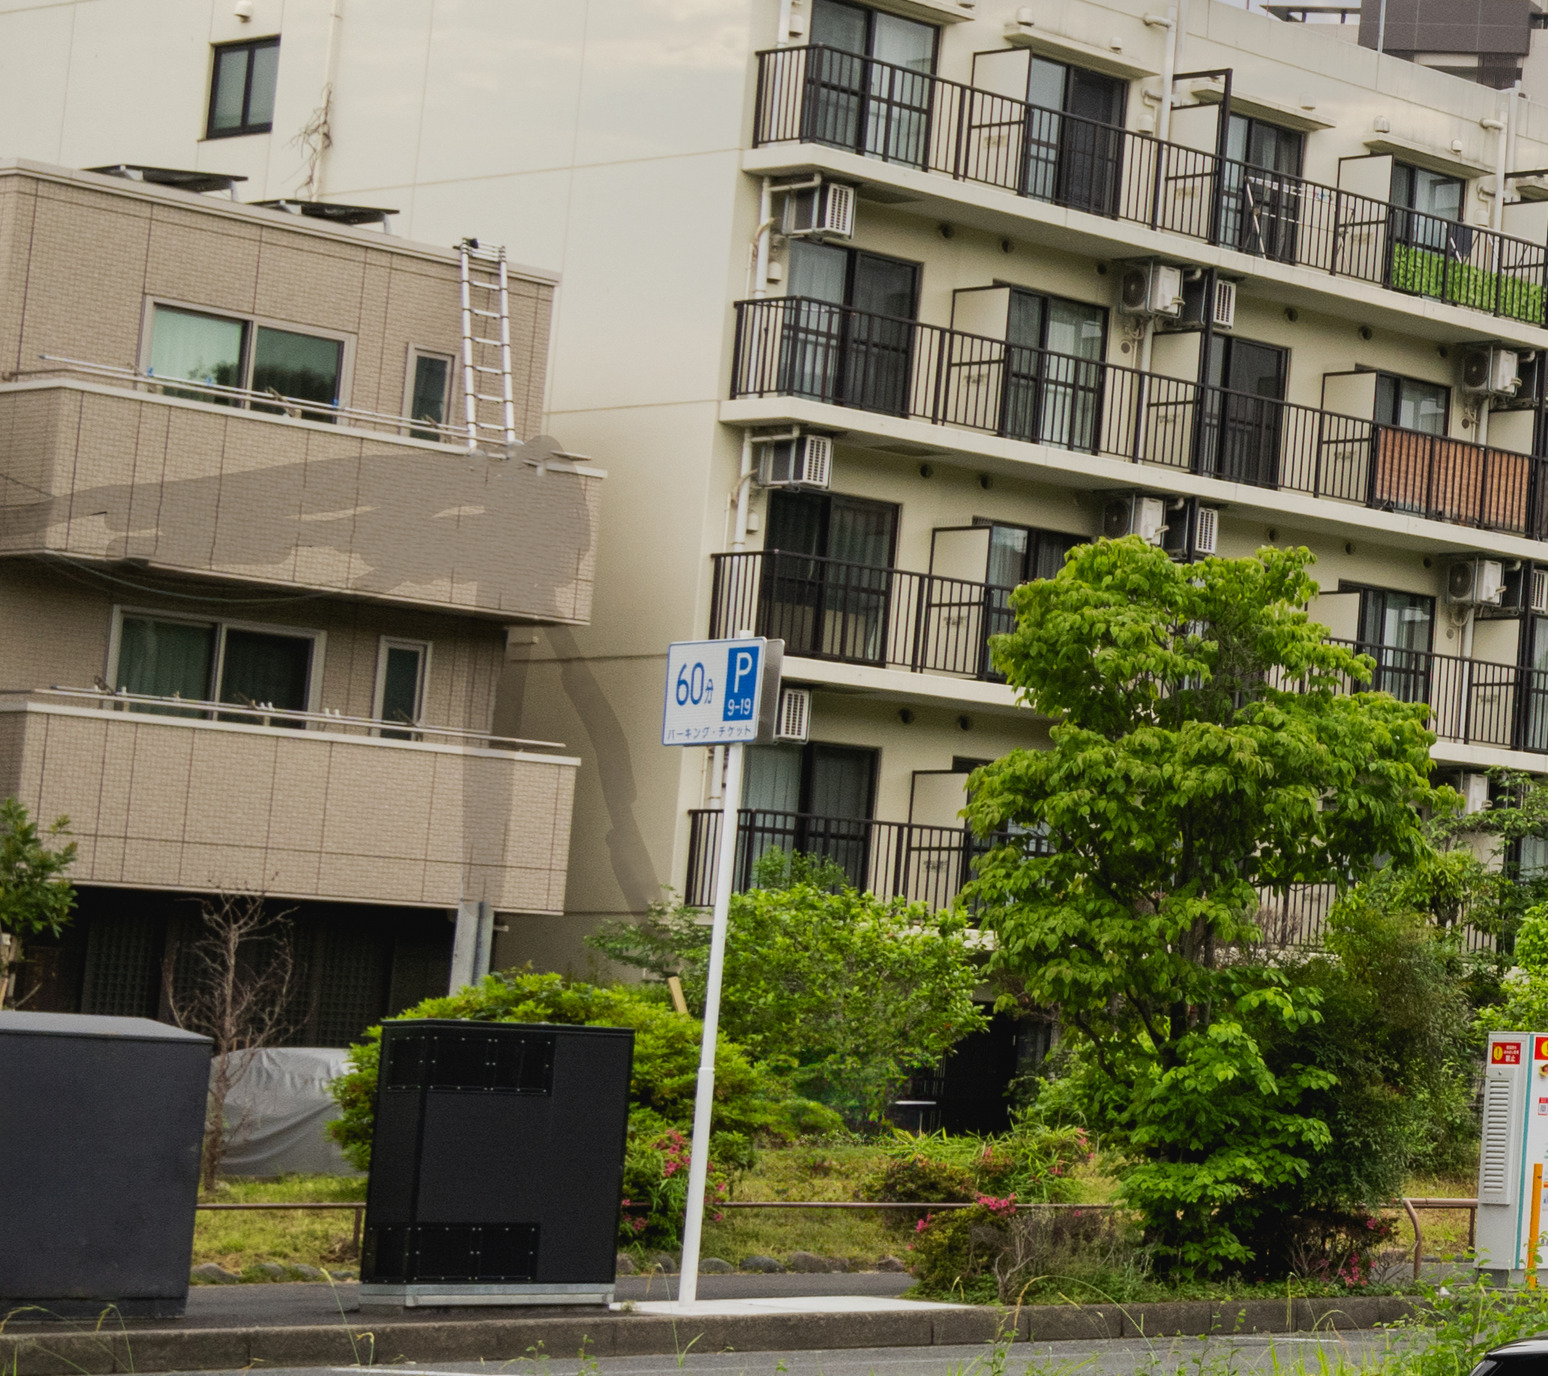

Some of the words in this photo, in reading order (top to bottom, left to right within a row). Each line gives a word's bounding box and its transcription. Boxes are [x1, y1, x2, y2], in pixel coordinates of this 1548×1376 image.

[734, 651, 752, 693] P
[728, 698, 751, 716] 9-19
[667, 725, 751, 741] パーキング・チケット
